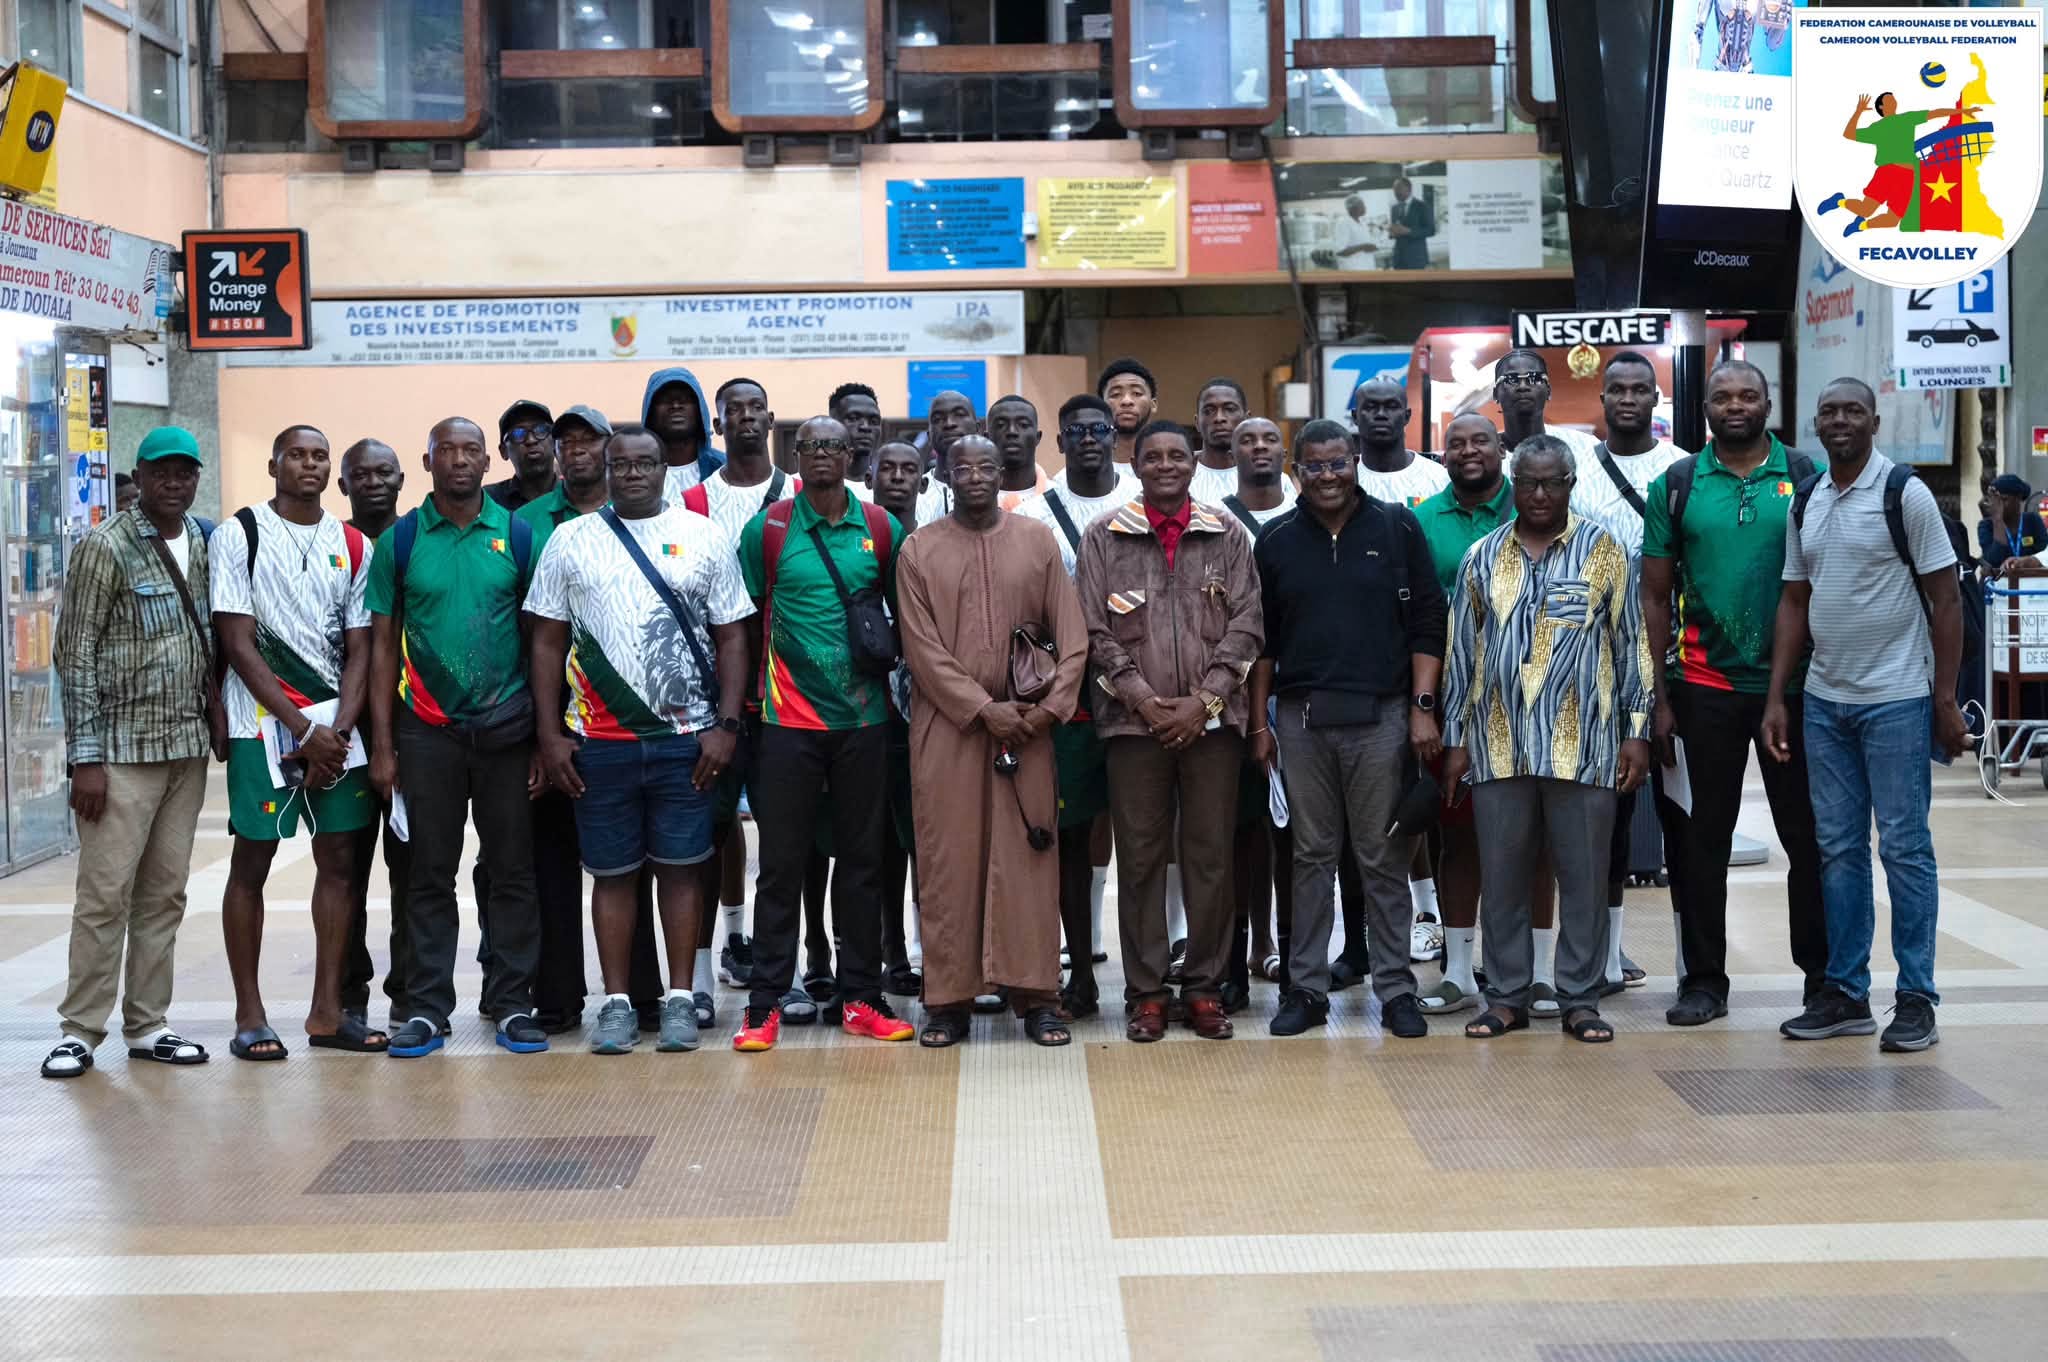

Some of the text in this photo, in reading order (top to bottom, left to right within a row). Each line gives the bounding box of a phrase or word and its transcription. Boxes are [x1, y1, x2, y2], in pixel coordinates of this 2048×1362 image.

[1744, 95, 1774, 112] une
[29, 117, 53, 145] MTN
[1720, 168, 1773, 190] Quartz
[2, 202, 112, 260] DE SERVICES Sarl
[5, 237, 39, 261] Journaux
[1693, 250, 1750, 267] JCDecaux
[78, 277, 93, 299] 33
[95, 282, 109, 304] 02
[111, 287, 125, 309] 42
[209, 281, 267, 298] Orange
[1963, 273, 1989, 310] P
[0, 286, 72, 321] DE DOUALA
[209, 297, 262, 314] Money
[346, 301, 581, 320] AGENCE DE PROMOTION
[665, 296, 913, 314] INVESTMENT PROMOTION
[955, 301, 991, 318] IPA
[209, 318, 264, 331] #150#
[350, 319, 579, 337] DES INVESTISSEMENTS
[747, 314, 827, 329] AGENCY
[1919, 377, 1986, 387] LOUNGES
